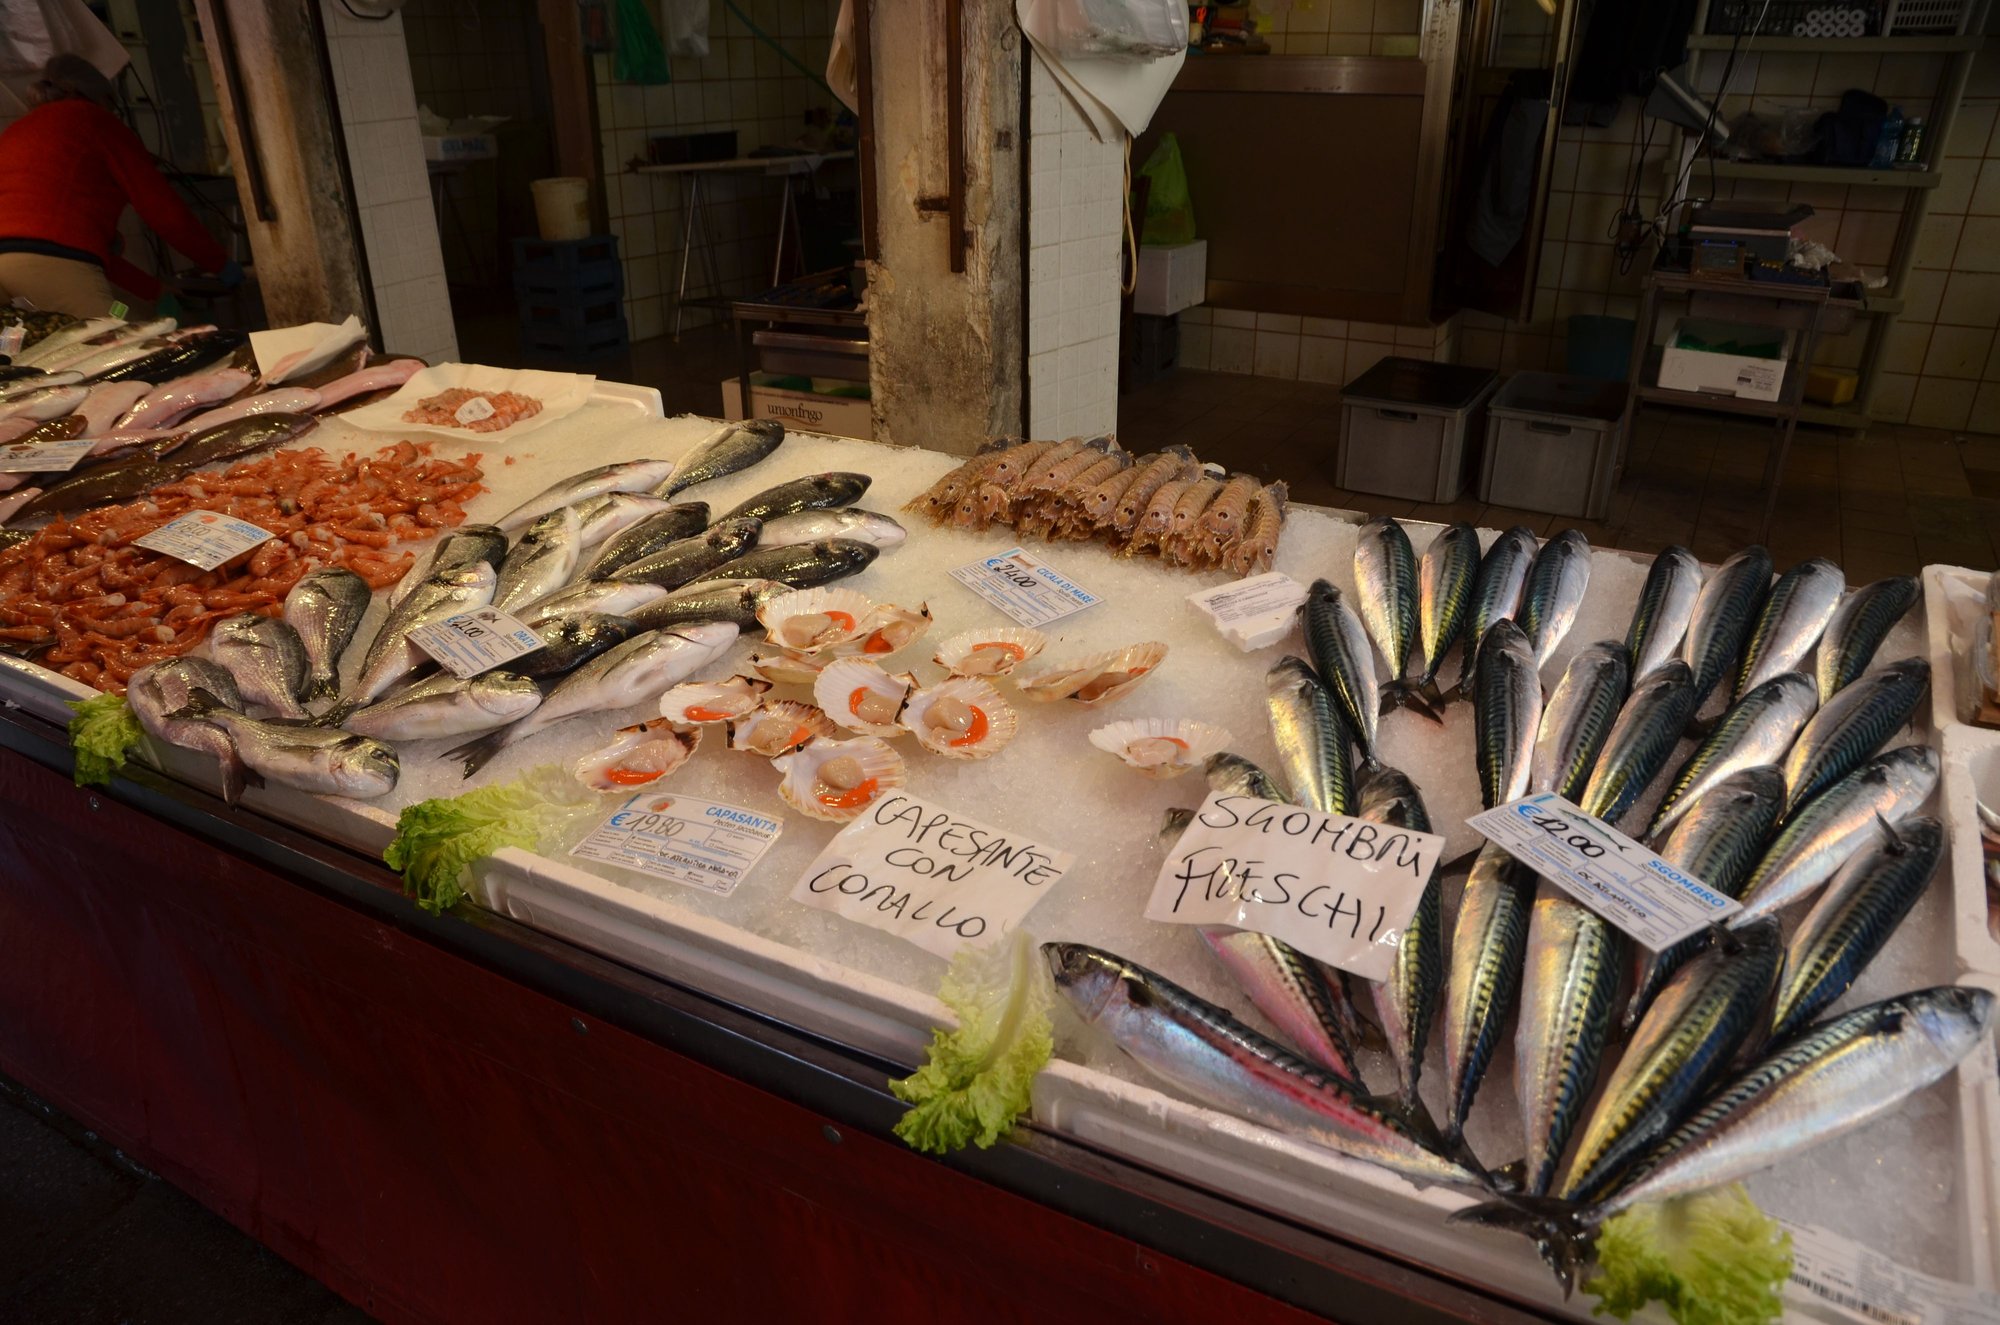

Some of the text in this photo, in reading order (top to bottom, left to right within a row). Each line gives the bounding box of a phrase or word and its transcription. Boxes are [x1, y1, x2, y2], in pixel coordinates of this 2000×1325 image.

[767, 402, 823, 423] unionfrigo
[1036, 567, 1063, 586] CICALA
[1061, 581, 1072, 591] DI
[1071, 588, 1095, 604] MARE
[513, 630, 537, 649] ORATA
[610, 812, 631, 827] €
[625, 814, 685, 836] 19.80
[705, 806, 778, 833] CAPASANTA
[1199, 796, 1422, 877] SGOMBRI
[1518, 804, 1543, 819] €
[1532, 815, 1606, 858] 12.00
[875, 796, 1062, 886] CAPESANTE
[885, 848, 974, 882] CON
[1648, 860, 1726, 907] SGOMBRO
[809, 864, 986, 937] CORALLO
[1173, 847, 1385, 941] FRESCHI
